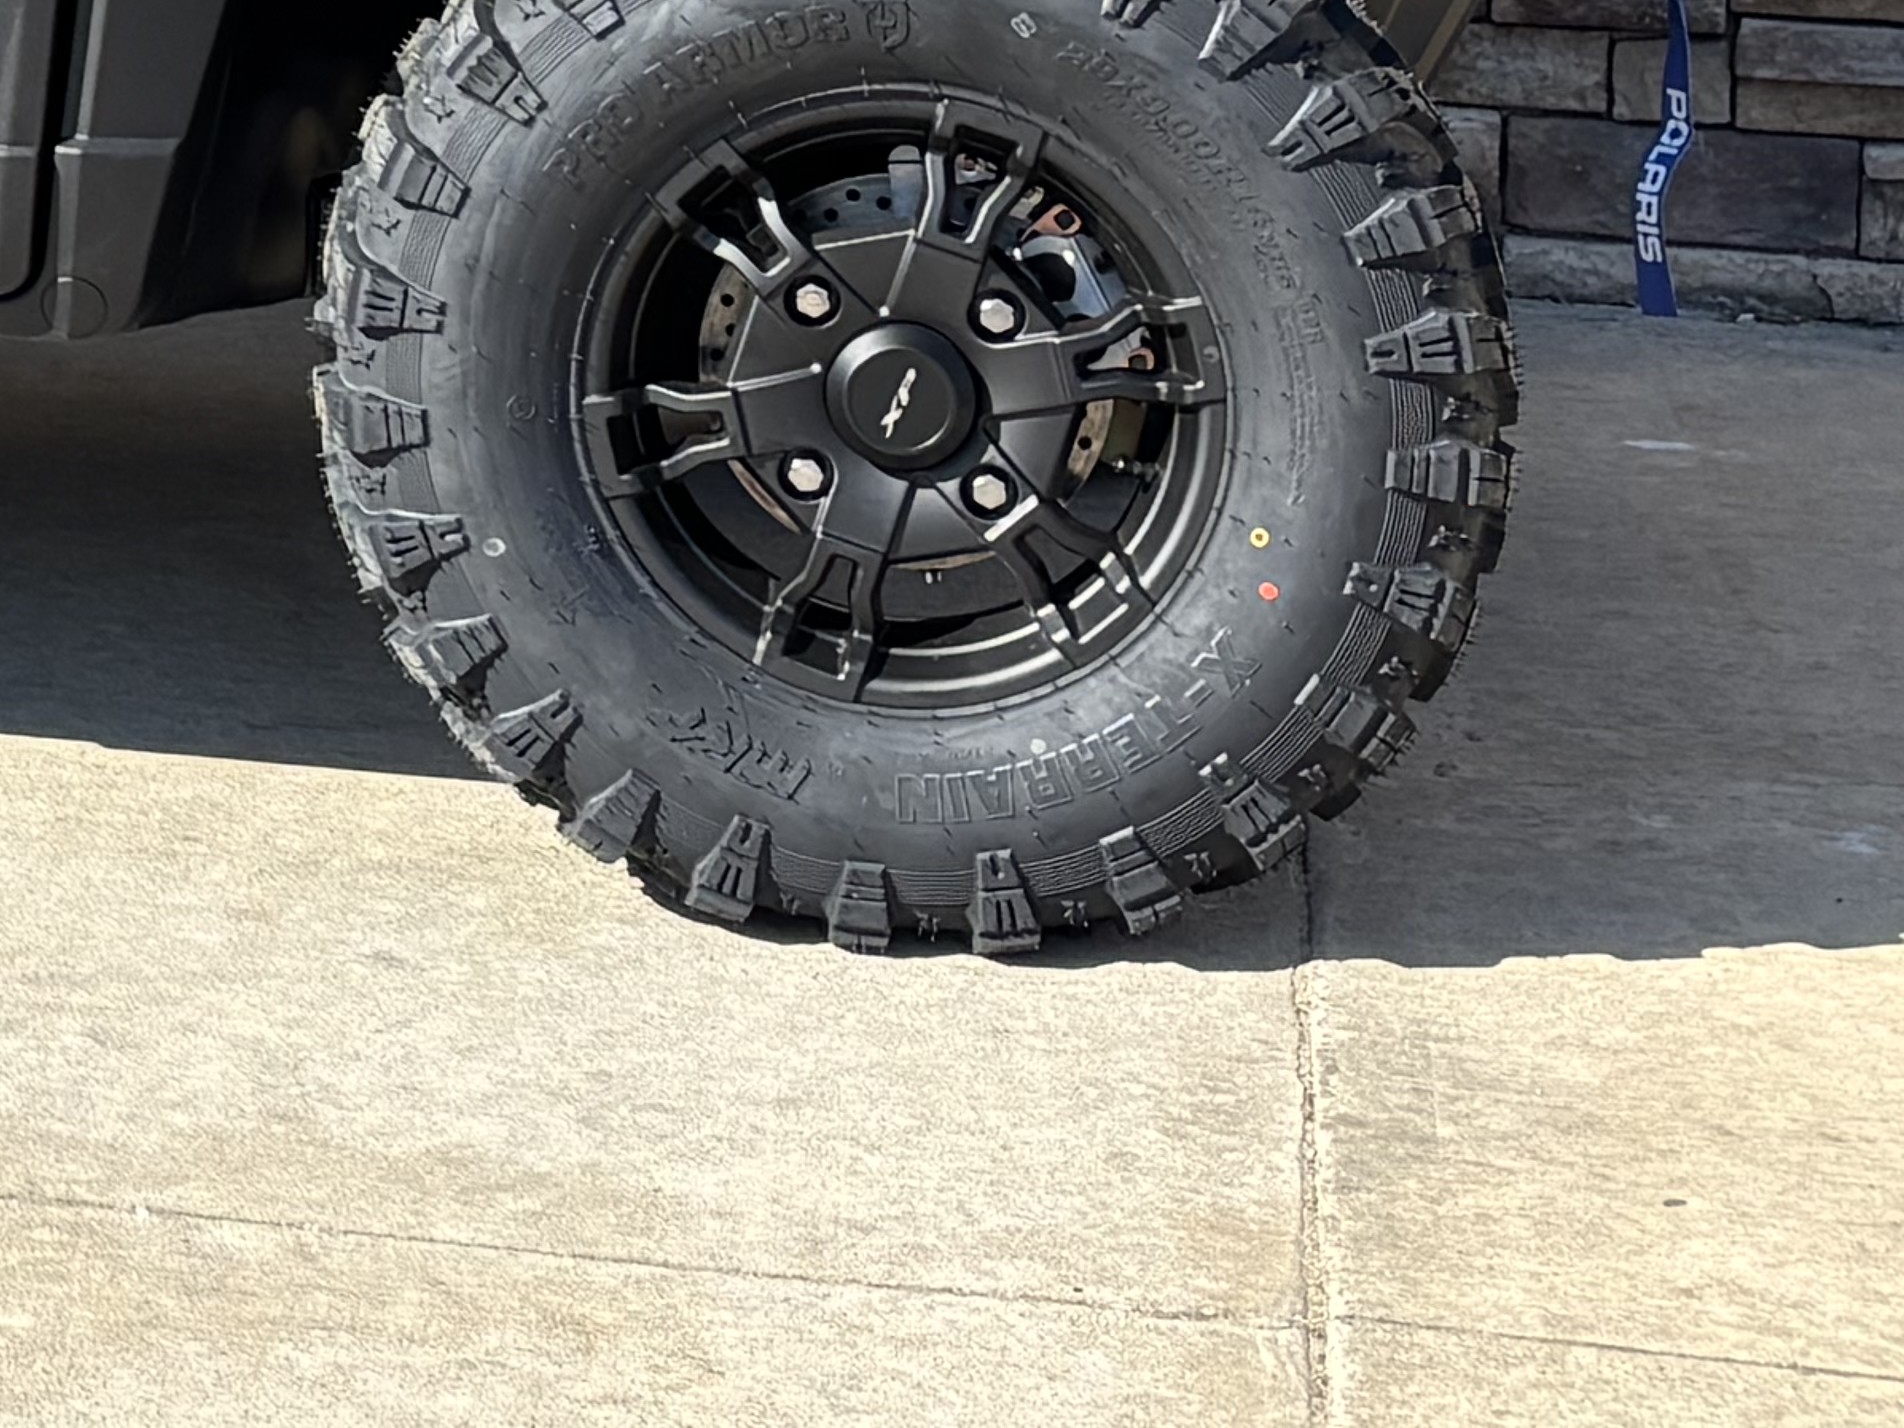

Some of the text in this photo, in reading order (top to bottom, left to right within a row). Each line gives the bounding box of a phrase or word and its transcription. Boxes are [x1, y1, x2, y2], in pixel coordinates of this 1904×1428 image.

[642, 3, 852, 96] ARMOR
[1634, 87, 1691, 263] POLARIS
[895, 624, 1262, 824] X-TERRAIN
